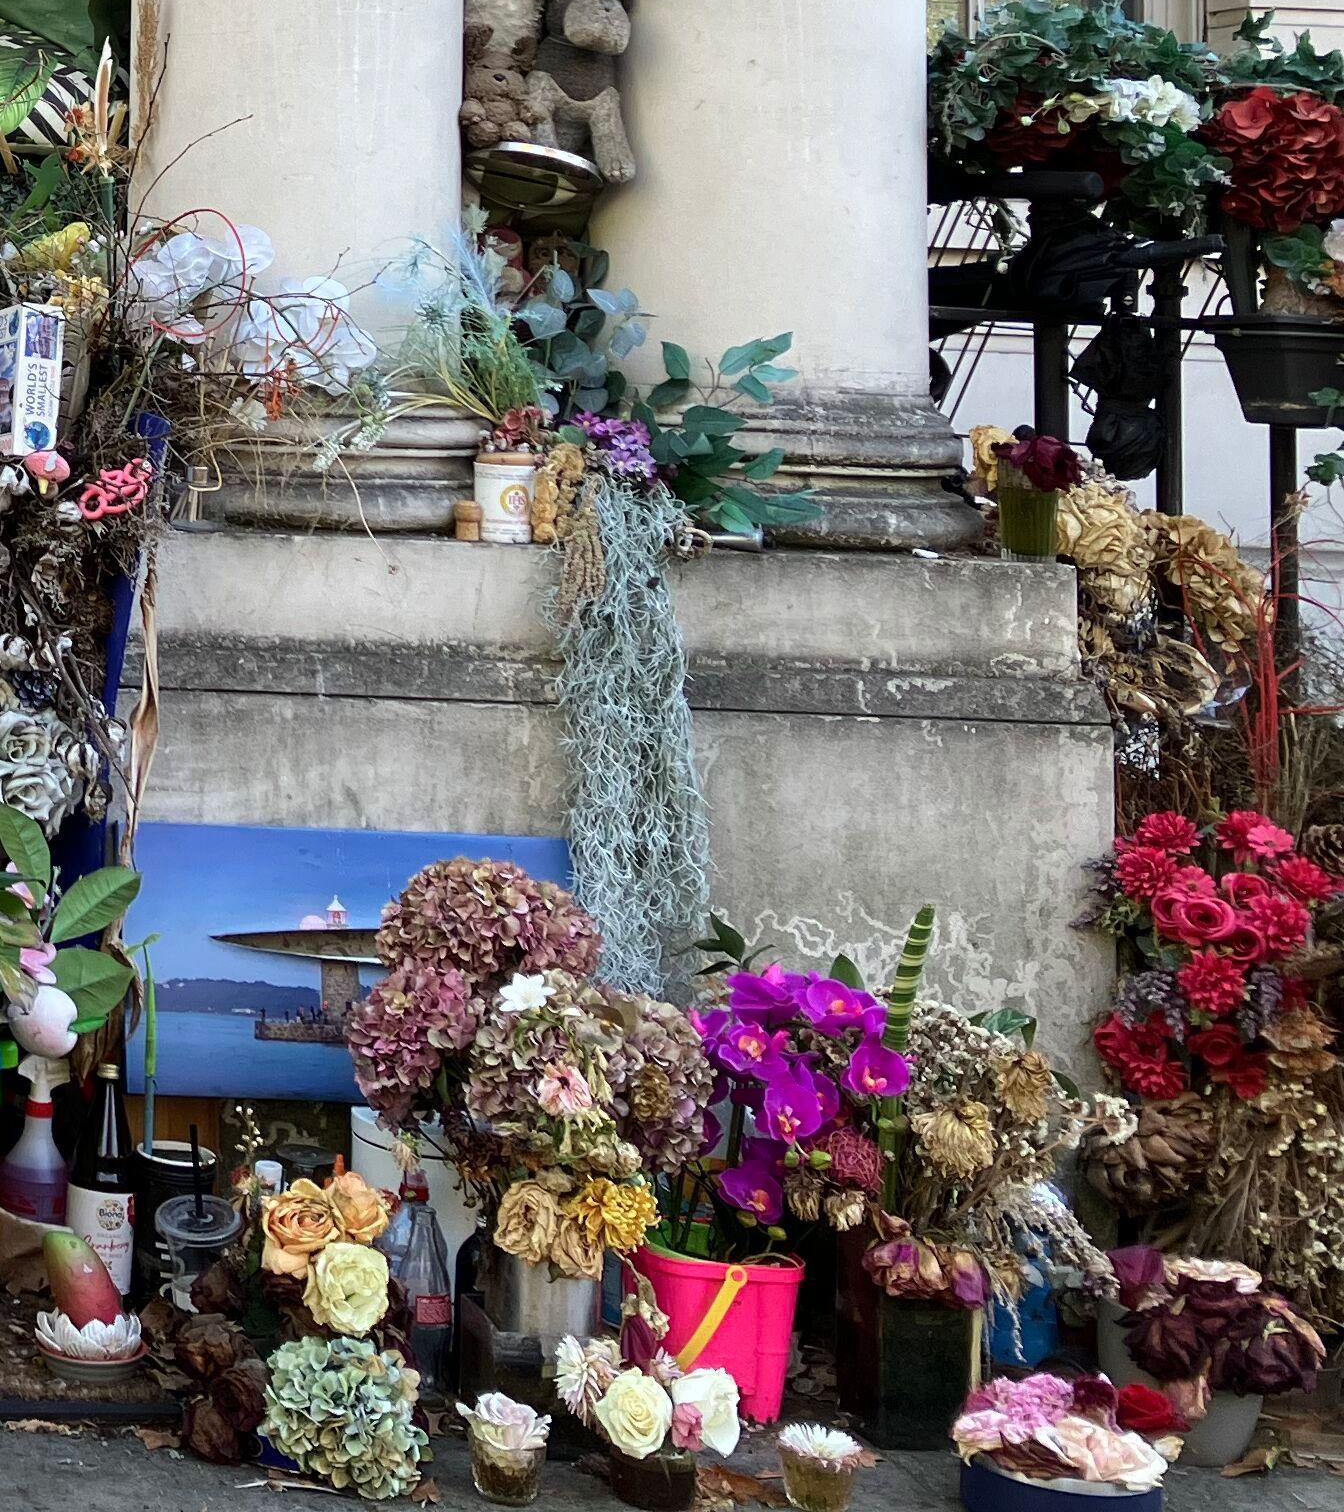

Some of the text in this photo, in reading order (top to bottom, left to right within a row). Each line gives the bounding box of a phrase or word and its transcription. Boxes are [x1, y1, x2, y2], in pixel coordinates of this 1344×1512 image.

[25, 363, 38, 417] WORLD'S
[36, 364, 48, 417] SMALLEST
[99, 1208, 123, 1218] Biona
